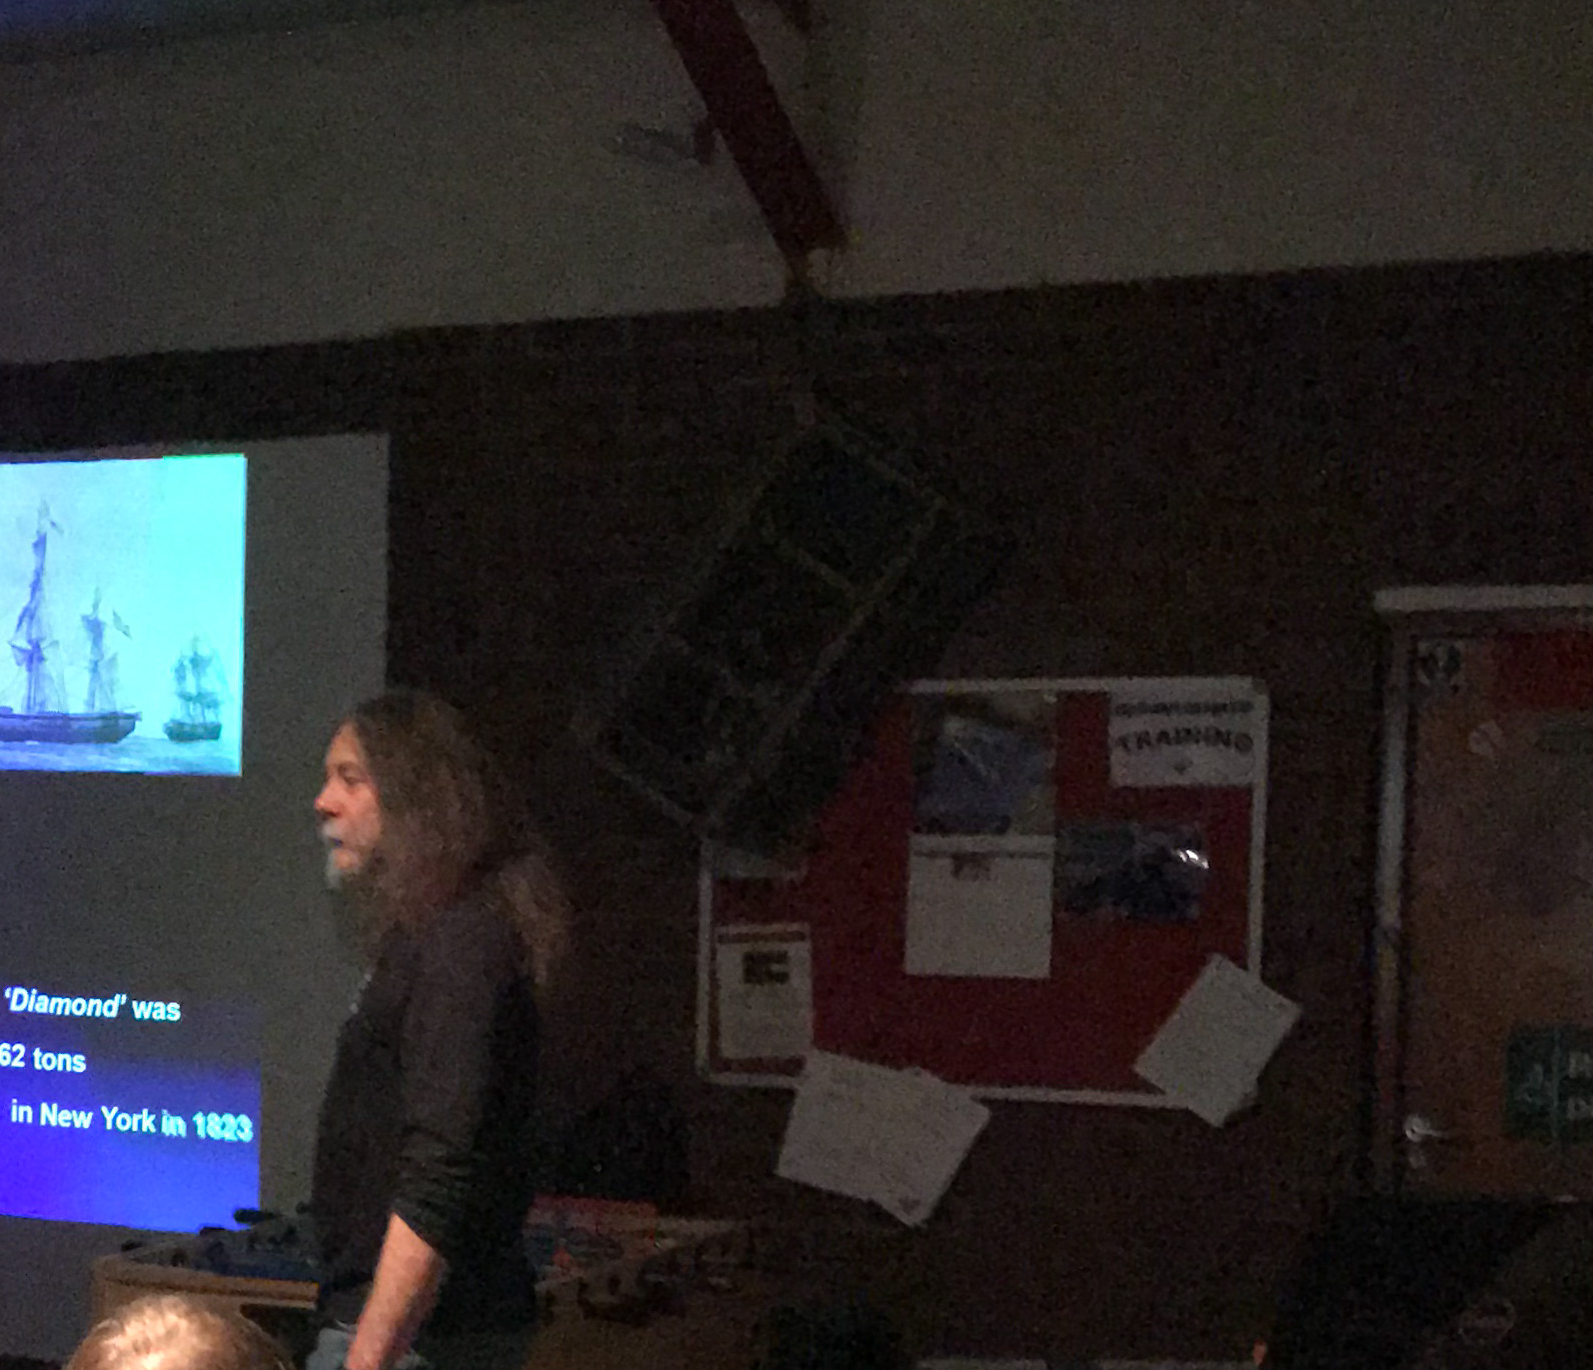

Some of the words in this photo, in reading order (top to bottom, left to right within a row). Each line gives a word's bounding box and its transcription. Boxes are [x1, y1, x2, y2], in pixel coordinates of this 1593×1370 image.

[132, 999, 182, 1022] was
[32, 1047, 87, 1073] tons
[10, 1098, 33, 1124] in
[39, 1102, 93, 1129] New
[100, 1106, 156, 1134] York
[161, 1109, 187, 1138] in
[192, 1111, 254, 1142] 1823
